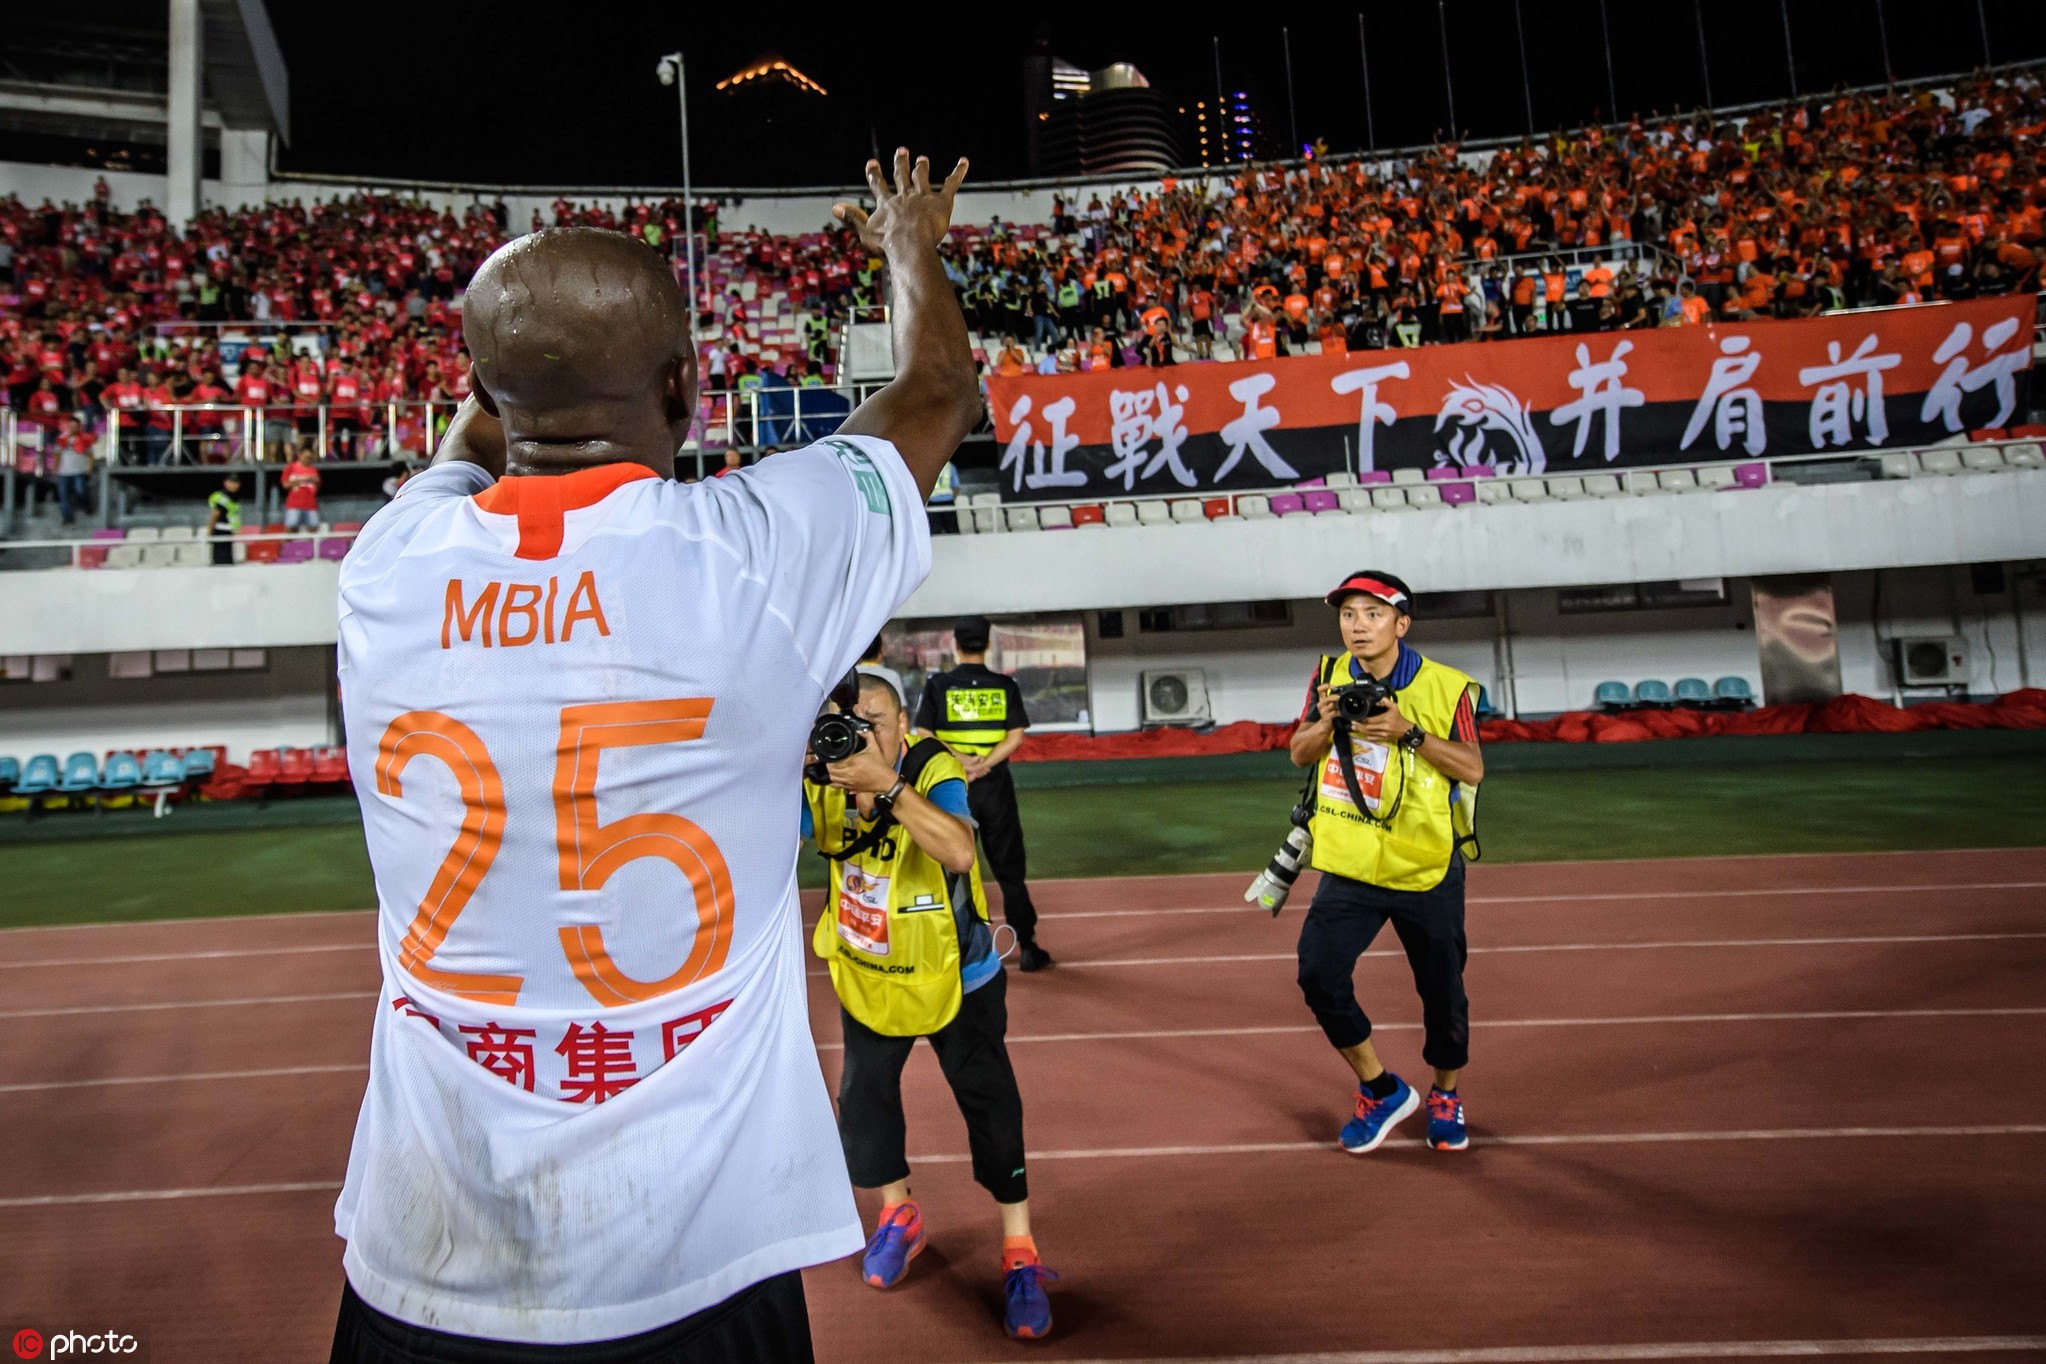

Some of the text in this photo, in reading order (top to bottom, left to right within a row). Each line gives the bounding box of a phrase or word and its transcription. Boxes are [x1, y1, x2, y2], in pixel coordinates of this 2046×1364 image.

[1000, 361, 1411, 493] 征戰天下
[1549, 316, 2032, 462] 并肩前行
[439, 570, 611, 650] MBIA
[375, 696, 735, 1008] 25
